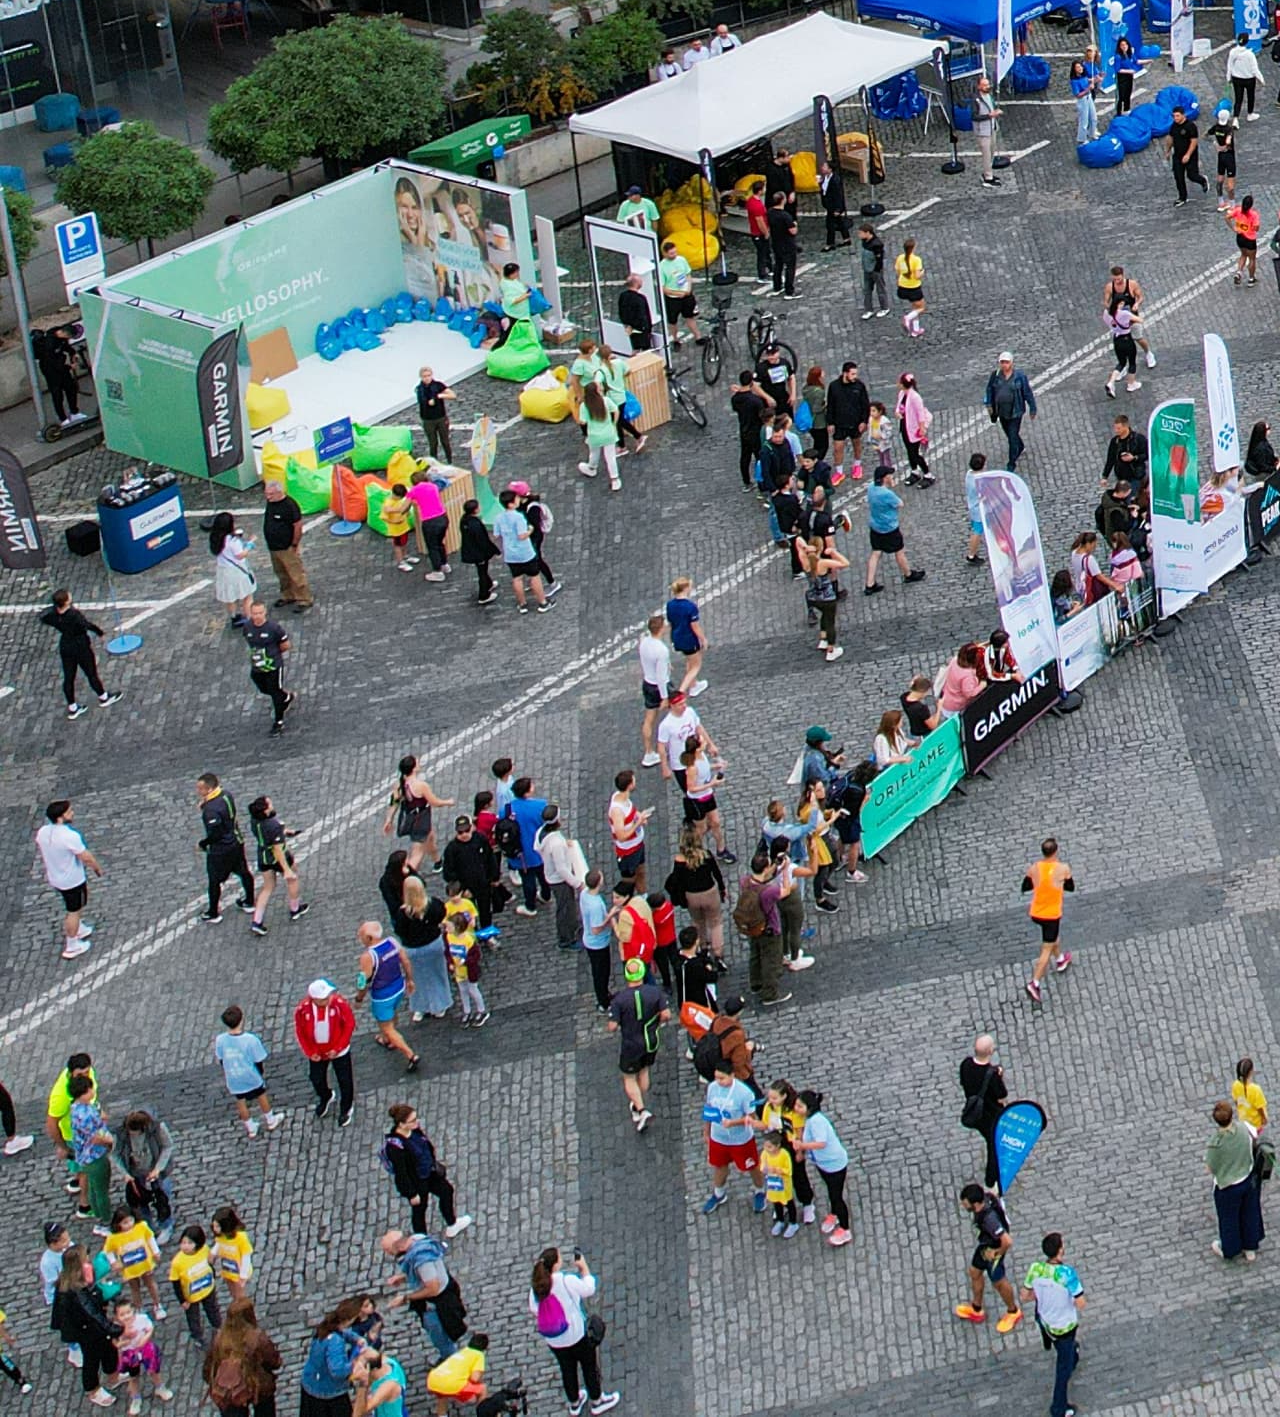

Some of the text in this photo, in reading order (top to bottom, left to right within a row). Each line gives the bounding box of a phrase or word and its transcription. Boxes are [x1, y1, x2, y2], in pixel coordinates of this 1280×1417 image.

[65, 220, 86, 250] P
[237, 245, 288, 273] ORIFLAME
[212, 362, 233, 453] GARMIN
[139, 507, 176, 528] GARMIN
[1261, 499, 1280, 528] PEAK
[973, 669, 1049, 742] GARMIN
[874, 742, 945, 807] ORIFLAME
